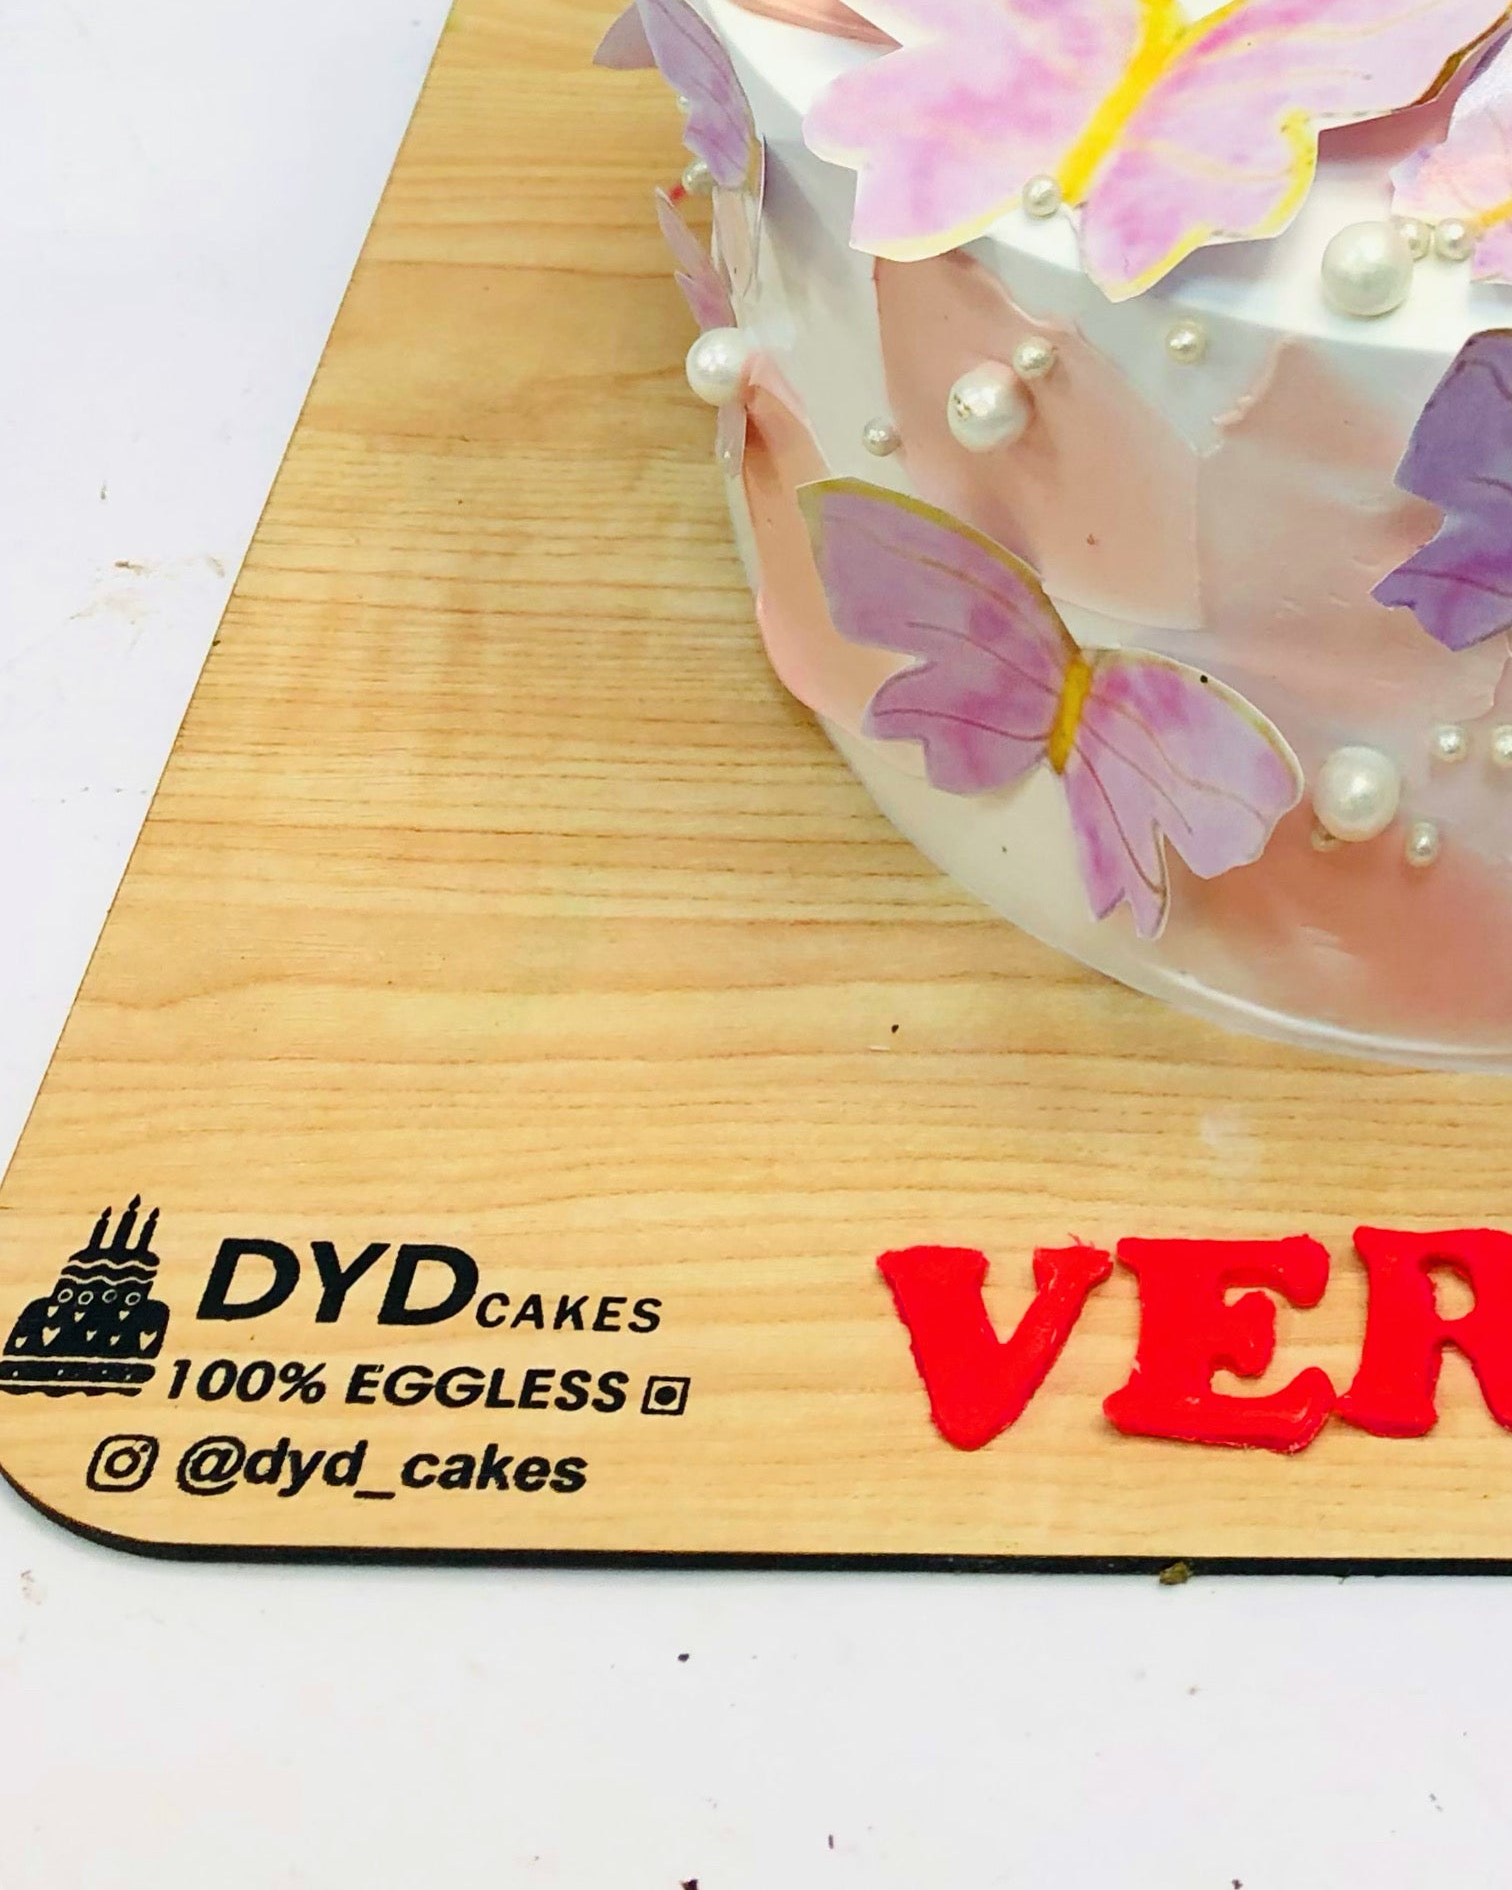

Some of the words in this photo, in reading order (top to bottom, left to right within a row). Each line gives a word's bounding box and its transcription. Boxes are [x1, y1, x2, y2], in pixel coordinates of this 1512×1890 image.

[196, 1237, 479, 1327] DYD
[475, 1292, 663, 1333] CAKES
[168, 1358, 327, 1405] 100%
[344, 1362, 630, 1414] EGGLESS
[176, 1434, 588, 1500] @dyd_cakes
